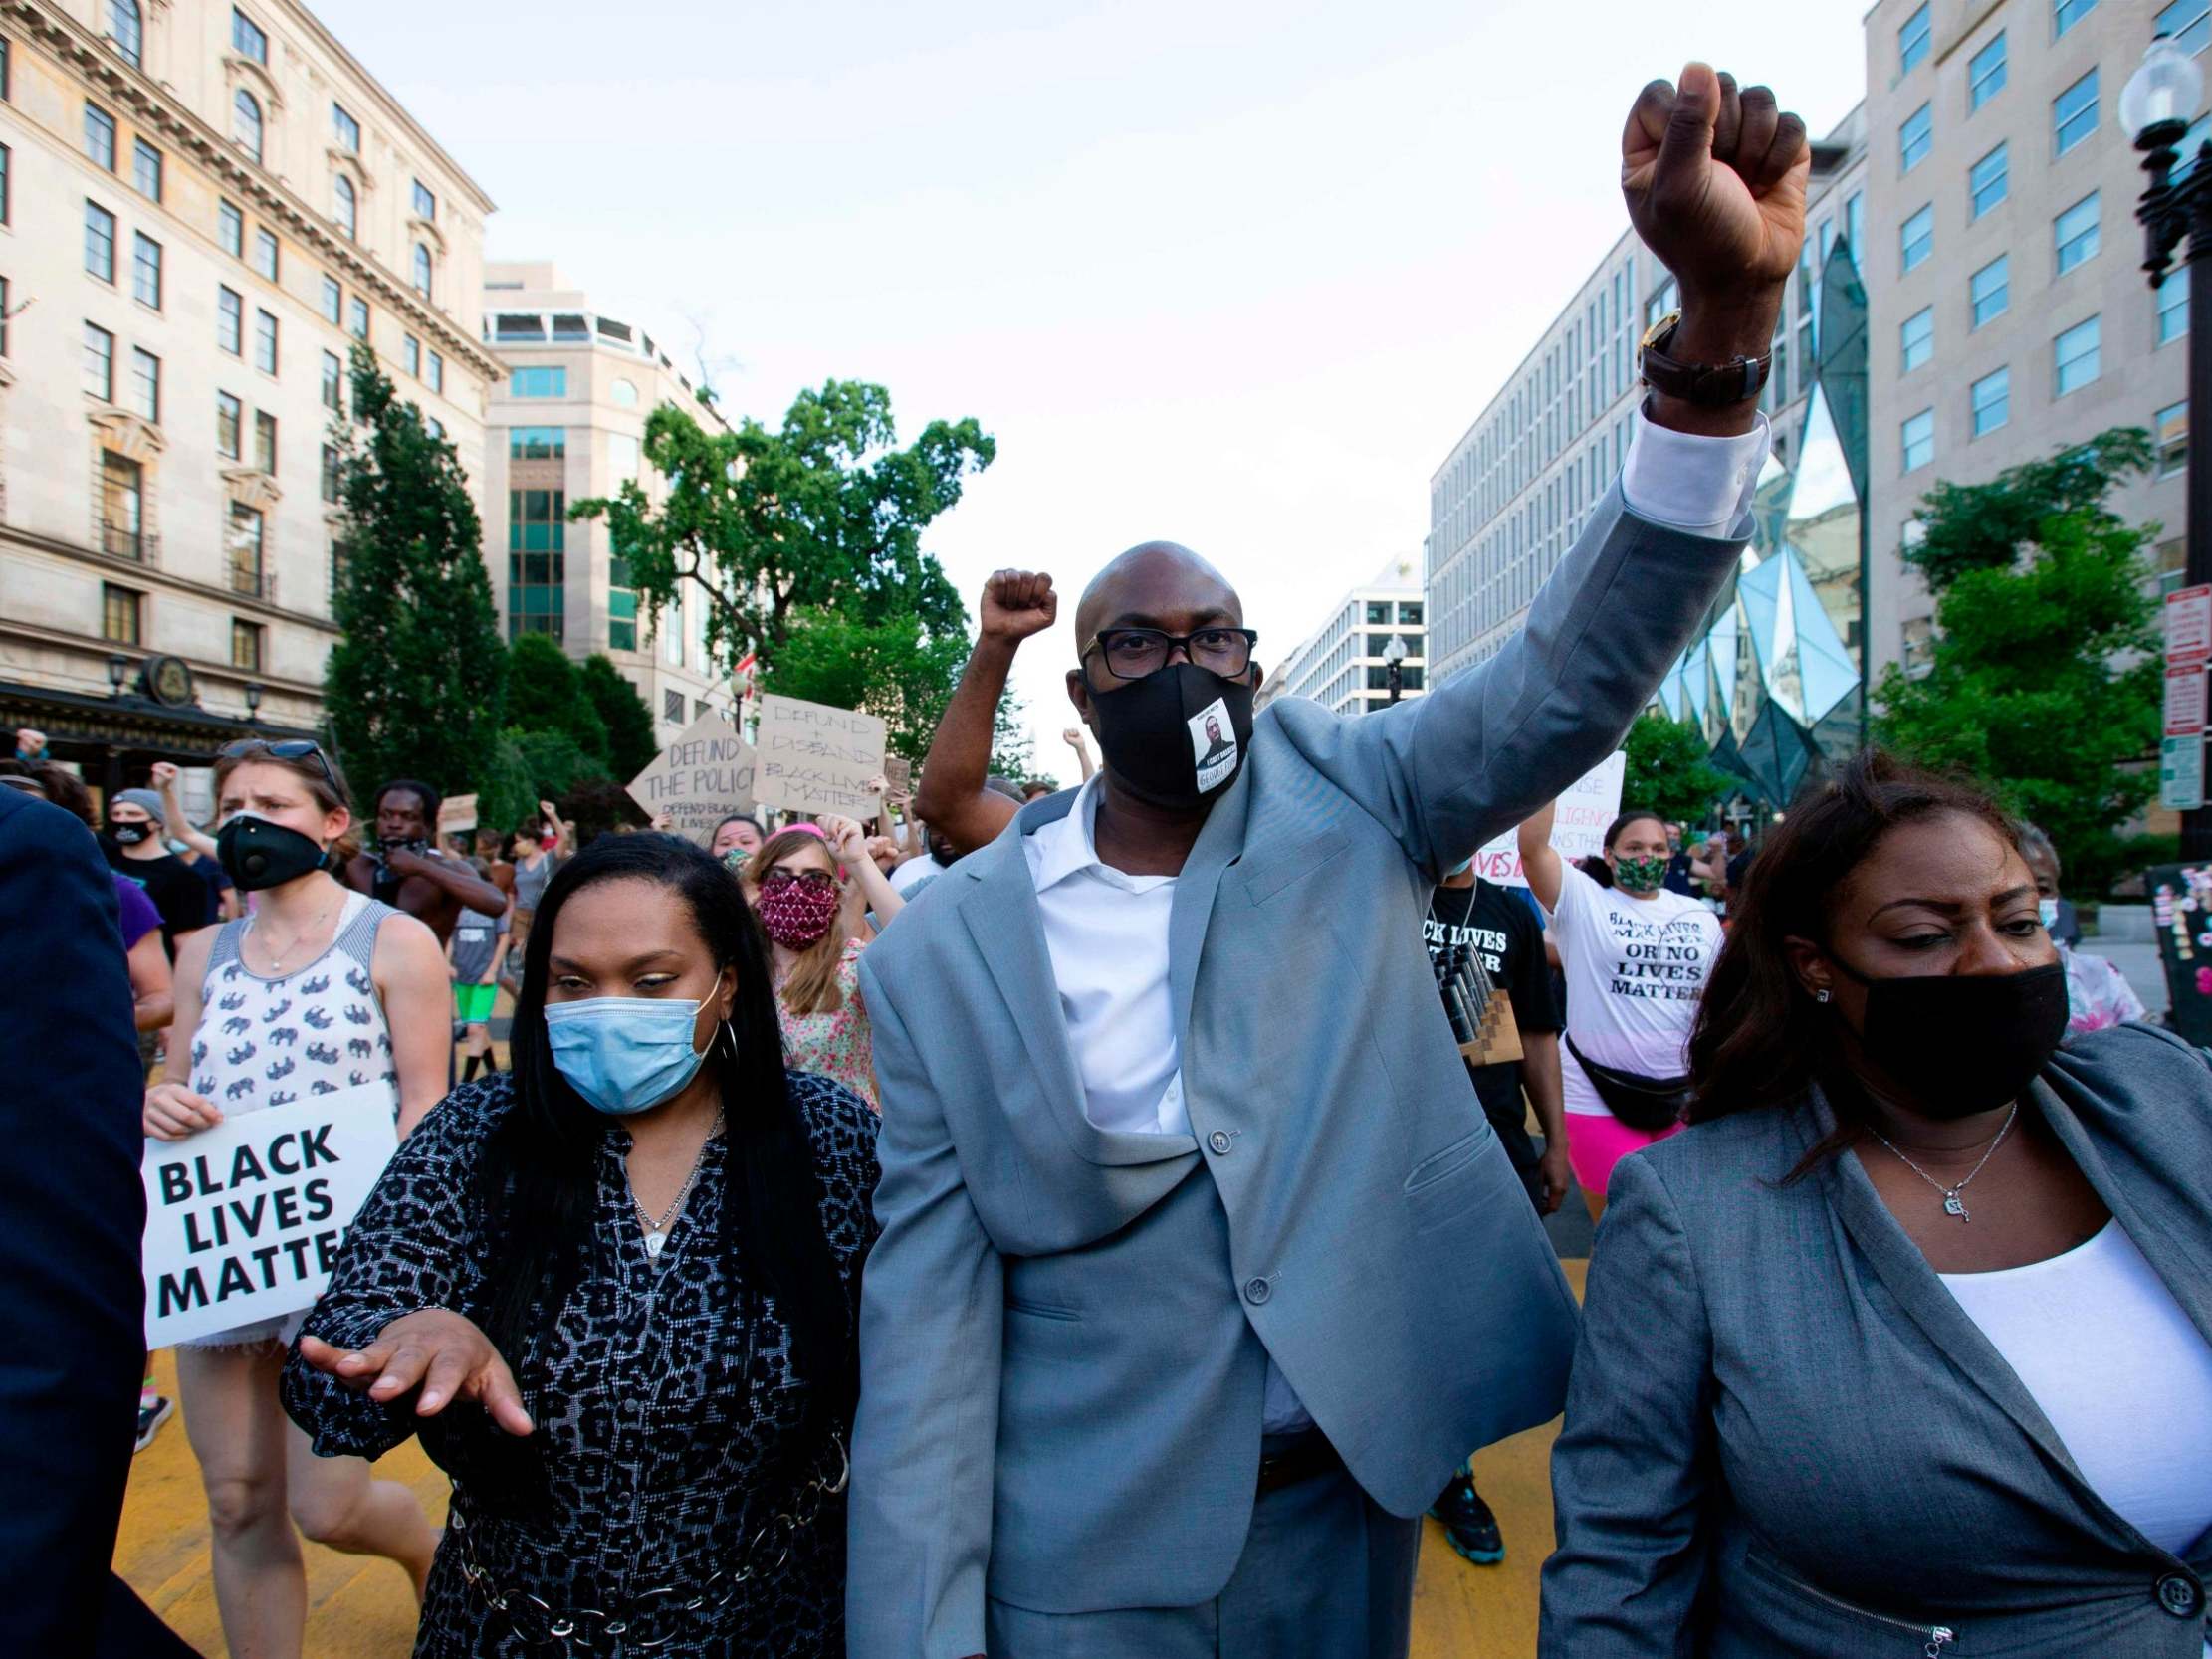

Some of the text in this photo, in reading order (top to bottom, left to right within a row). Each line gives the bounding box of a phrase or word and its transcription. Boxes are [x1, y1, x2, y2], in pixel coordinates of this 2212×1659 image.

[775, 705, 871, 734] DEFUND
[670, 737, 741, 768] DEFUND
[645, 771, 685, 800] THE
[765, 762, 826, 782] BLACK
[1449, 925, 1507, 953] LIVES
[1626, 943, 1700, 962] OR NO
[1617, 961, 1703, 981] LIVES
[158, 1123, 340, 1206] BLACK
[183, 1178, 334, 1254] LIVES
[157, 1225, 348, 1319] MATTE
